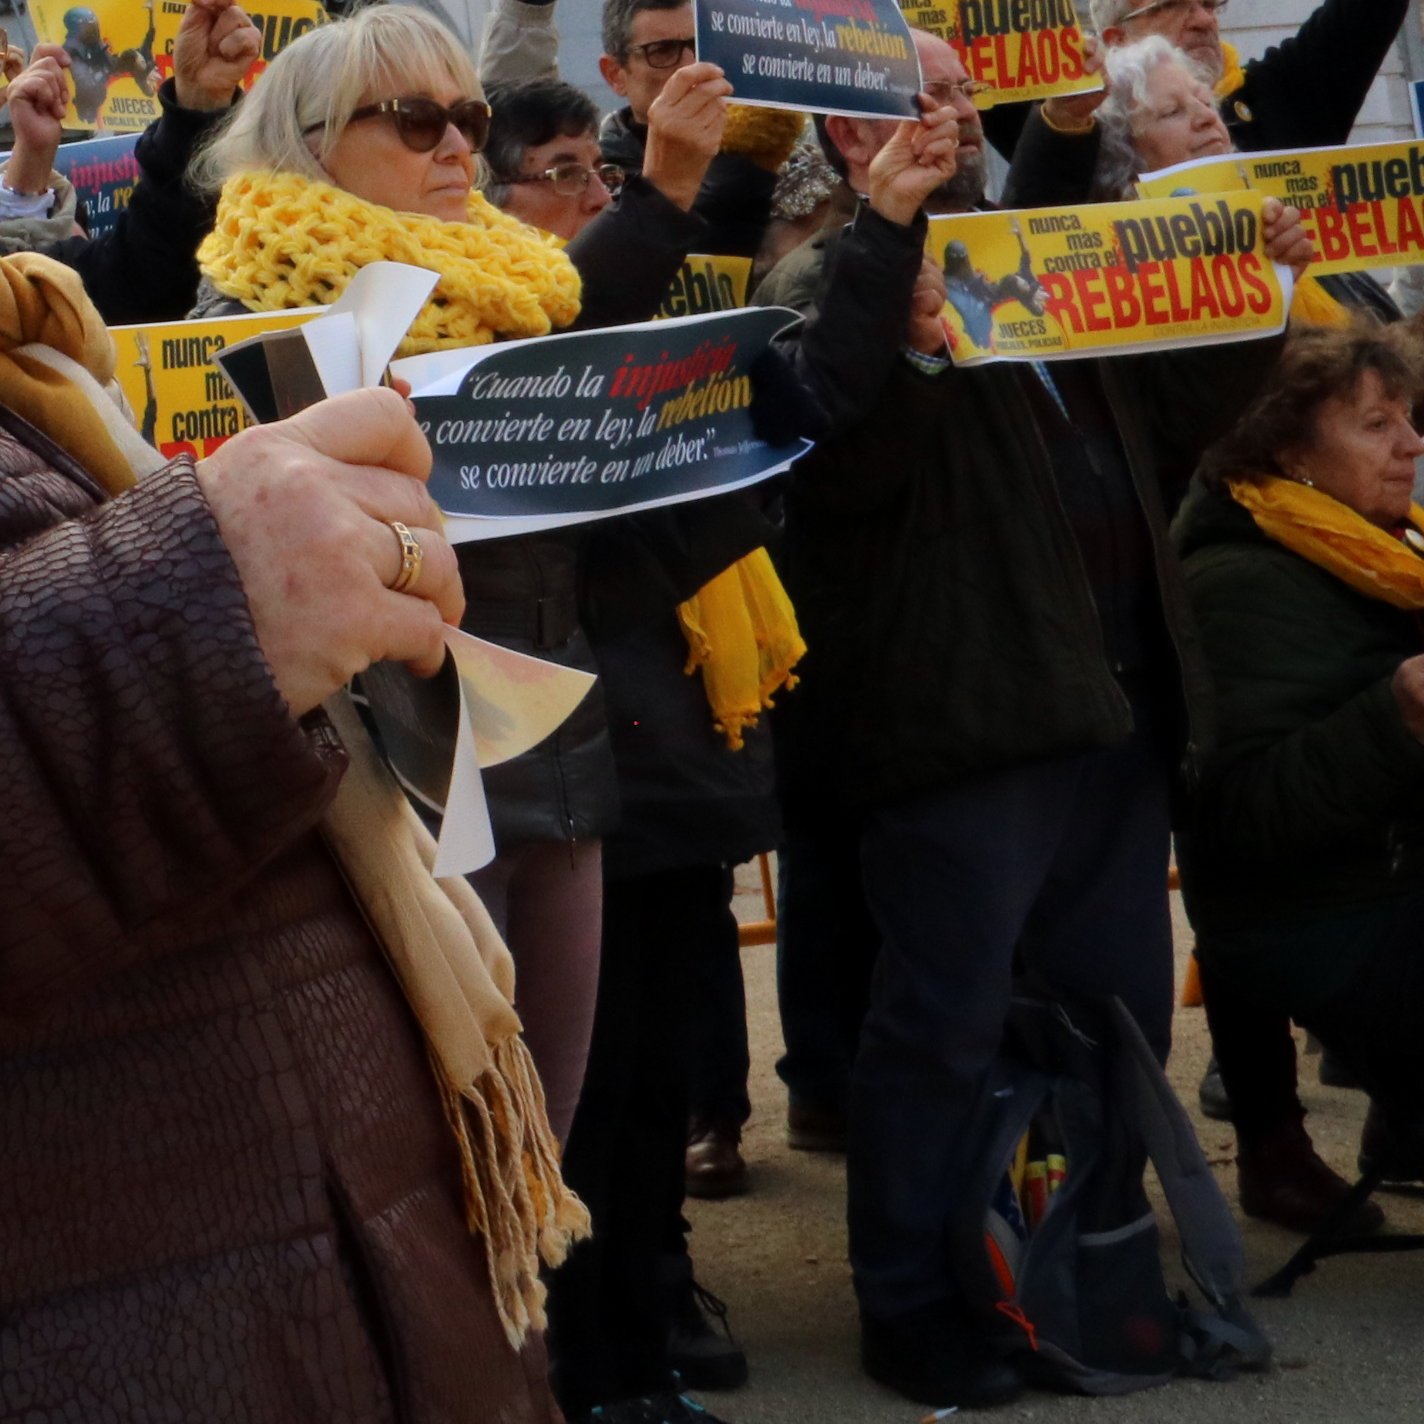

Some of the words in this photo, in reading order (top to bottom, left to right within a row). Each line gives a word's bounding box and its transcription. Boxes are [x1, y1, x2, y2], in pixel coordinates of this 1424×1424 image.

[711, 10, 724, 31] se
[727, 10, 784, 41] convierte
[786, 23, 802, 43] en
[822, 21, 837, 49] la
[742, 53, 755, 75] se
[758, 53, 814, 82] convierte
[817, 64, 832, 84] en
[834, 65, 852, 87] un
[109, 96, 156, 116] JUECES
[1253, 160, 1301, 179] nunca
[1332, 147, 1424, 213] pueb
[97, 191, 111, 214] la
[1027, 214, 1082, 235] nunca
[1113, 200, 1257, 274] pueblo
[1043, 250, 1102, 274] contra
[1104, 245, 1119, 268] el
[1036, 252, 1272, 334] REBELAOS
[575, 365, 605, 399] la
[172, 404, 239, 442] contra
[436, 411, 554, 445] convierte
[557, 418, 592, 442] en
[595, 408, 633, 450] ley,
[636, 406, 657, 438] la
[655, 365, 752, 432] rebelión
[460, 464, 481, 490] se
[486, 454, 598, 489] convierte
[601, 458, 630, 484] en
[631, 449, 655, 480] un
